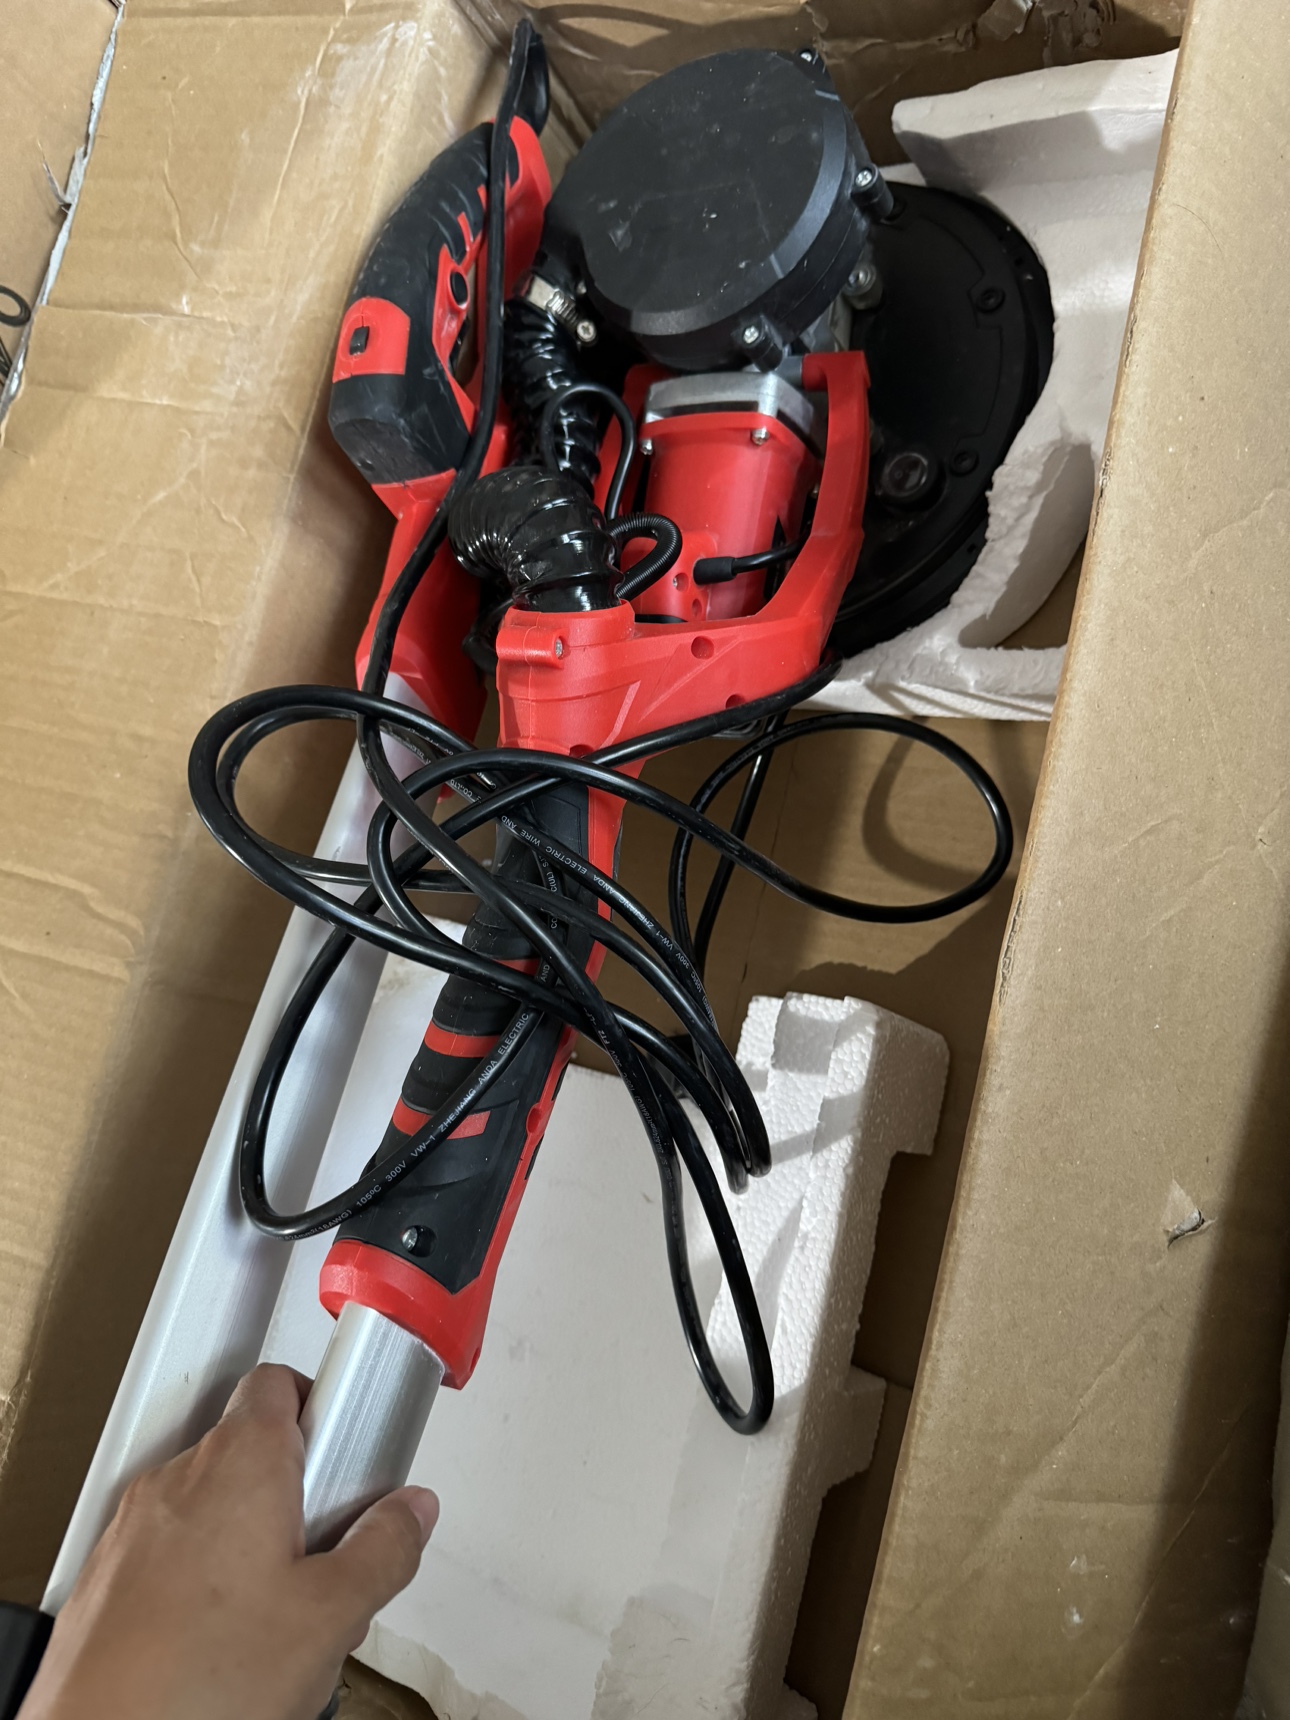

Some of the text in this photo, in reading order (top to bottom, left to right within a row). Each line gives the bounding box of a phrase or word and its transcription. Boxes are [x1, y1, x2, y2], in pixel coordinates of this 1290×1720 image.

[501, 814, 518, 830] AND
[520, 828, 542, 847] WIRE
[545, 845, 588, 875] ELECTRIC
[592, 874, 618, 896] ANDA
[617, 896, 655, 929] ZHEJIANG
[655, 930, 674, 950] VW-1
[540, 964, 551, 983] AND
[385, 1160, 407, 1183] 300V
[410, 1135, 436, 1158] VW-1
[437, 1088, 477, 1133] ZHEJIANG
[477, 1059, 498, 1086] ANDA
[497, 1013, 530, 1056] ELECTRIC
